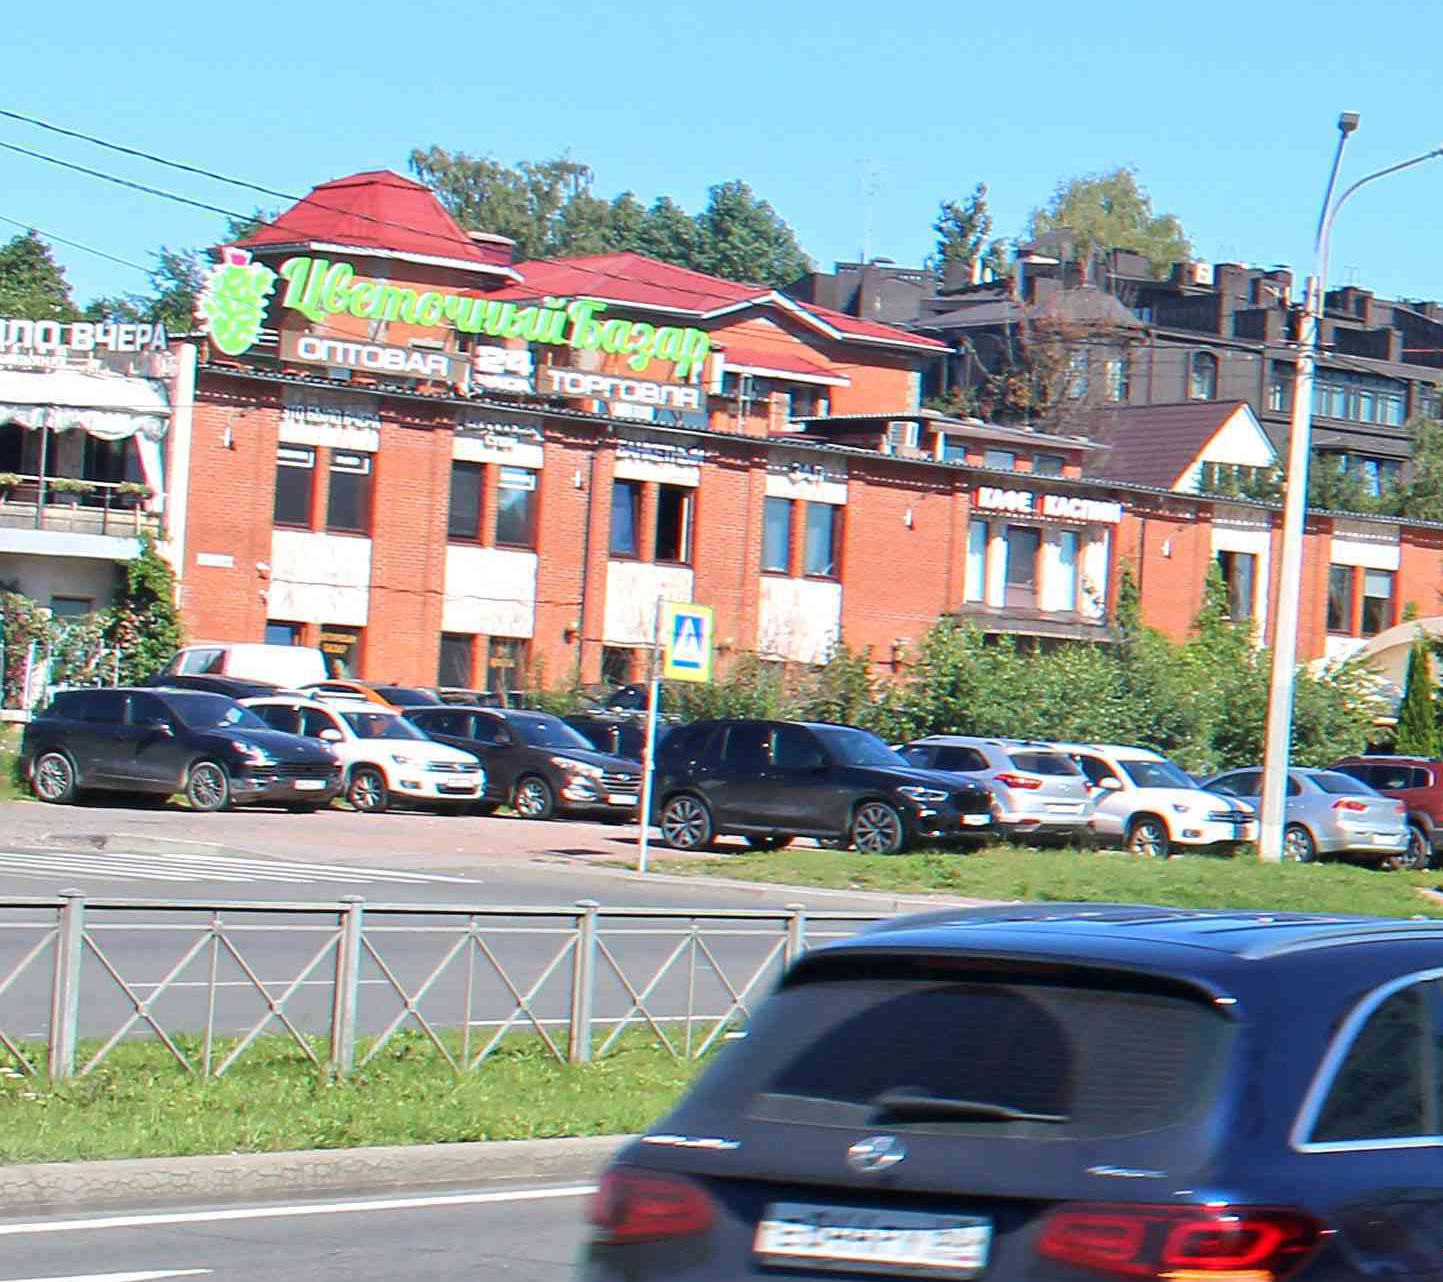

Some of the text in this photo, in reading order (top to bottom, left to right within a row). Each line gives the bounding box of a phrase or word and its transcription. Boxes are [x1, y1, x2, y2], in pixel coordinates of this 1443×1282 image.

[0, 319, 169, 353] ЛО ВЧЕРА
[279, 255, 711, 379] Цветочный Базар
[297, 336, 449, 377] ОПТОВАЯ
[549, 367, 701, 410] ТОРГОВЛЯ
